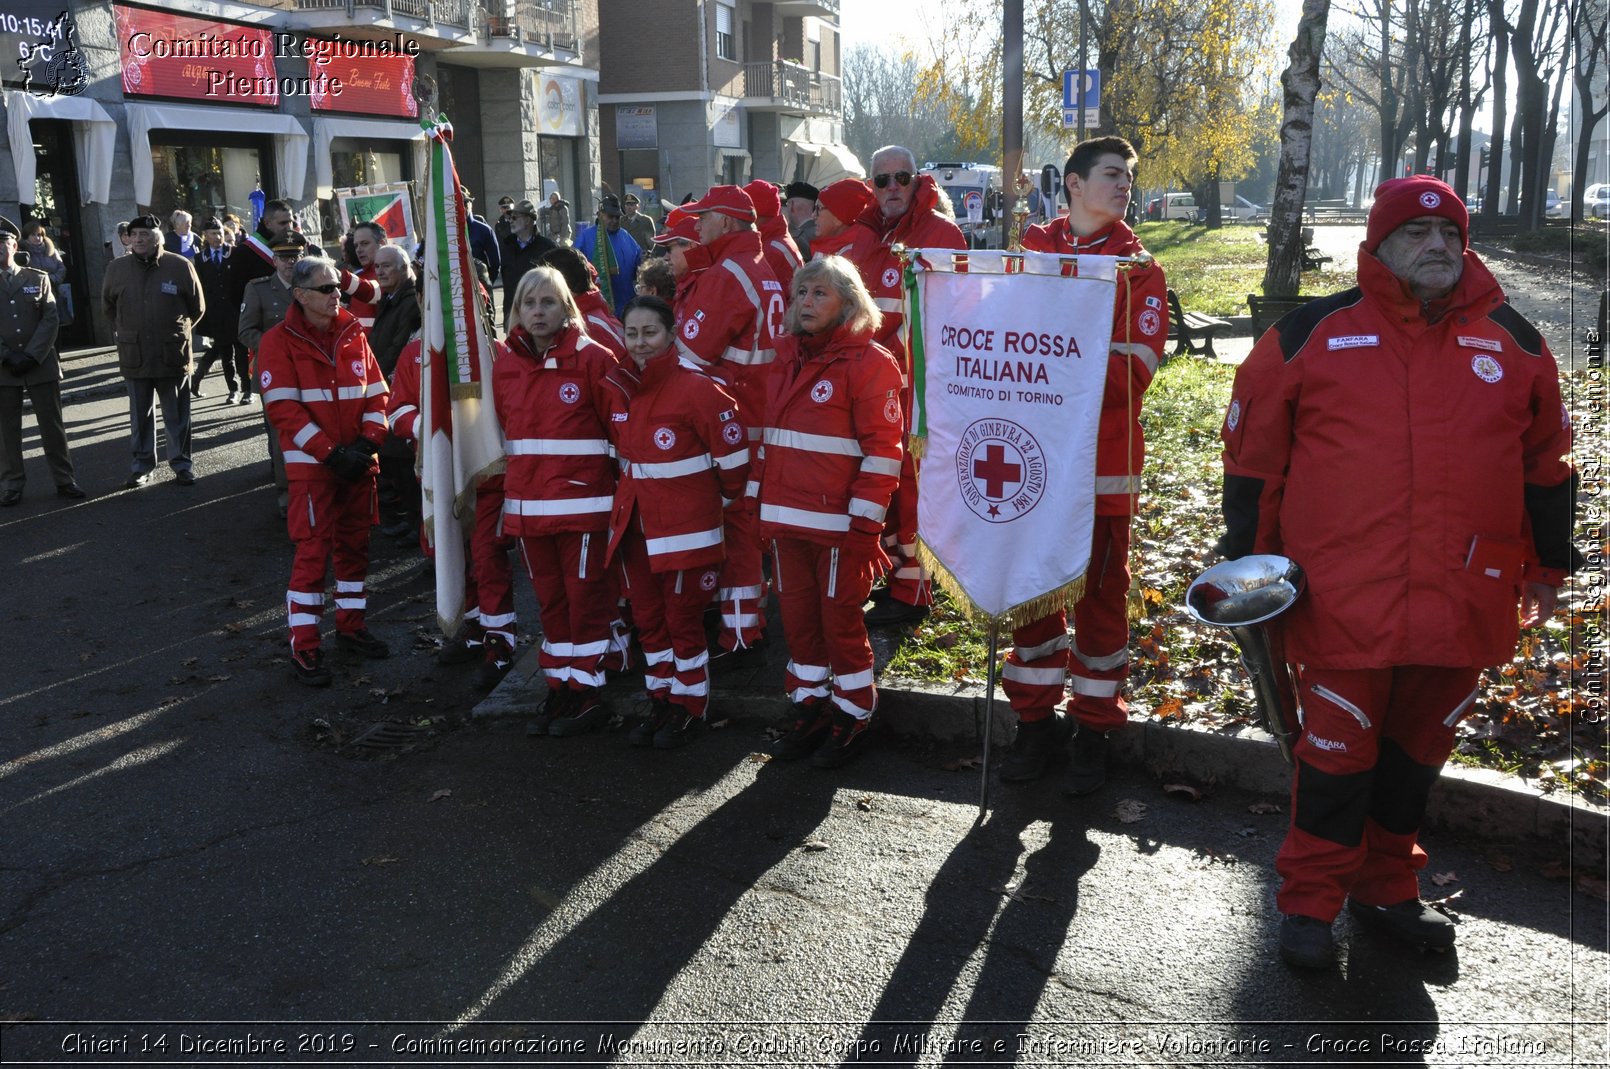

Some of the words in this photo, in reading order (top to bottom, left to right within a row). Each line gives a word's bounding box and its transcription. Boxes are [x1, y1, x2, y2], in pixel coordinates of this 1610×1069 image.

[1071, 74, 1092, 105] P
[451, 266, 467, 320] ROSSA
[942, 324, 994, 351] CROCE
[1004, 331, 1081, 359] ROSSA
[956, 356, 1049, 385] ITALIANA
[947, 383, 994, 400] COMITATO
[999, 390, 1010, 402] DI
[1017, 391, 1063, 406] TORINO
[969, 427, 980, 442] DI
[980, 423, 1022, 445] GINEVRA
[1020, 440, 1034, 454] 22
[959, 437, 980, 506] CONVENZIONE
[1026, 456, 1043, 494] AGOSTO
[1011, 492, 1033, 513] 1864
[1308, 731, 1346, 750] FANFARA
